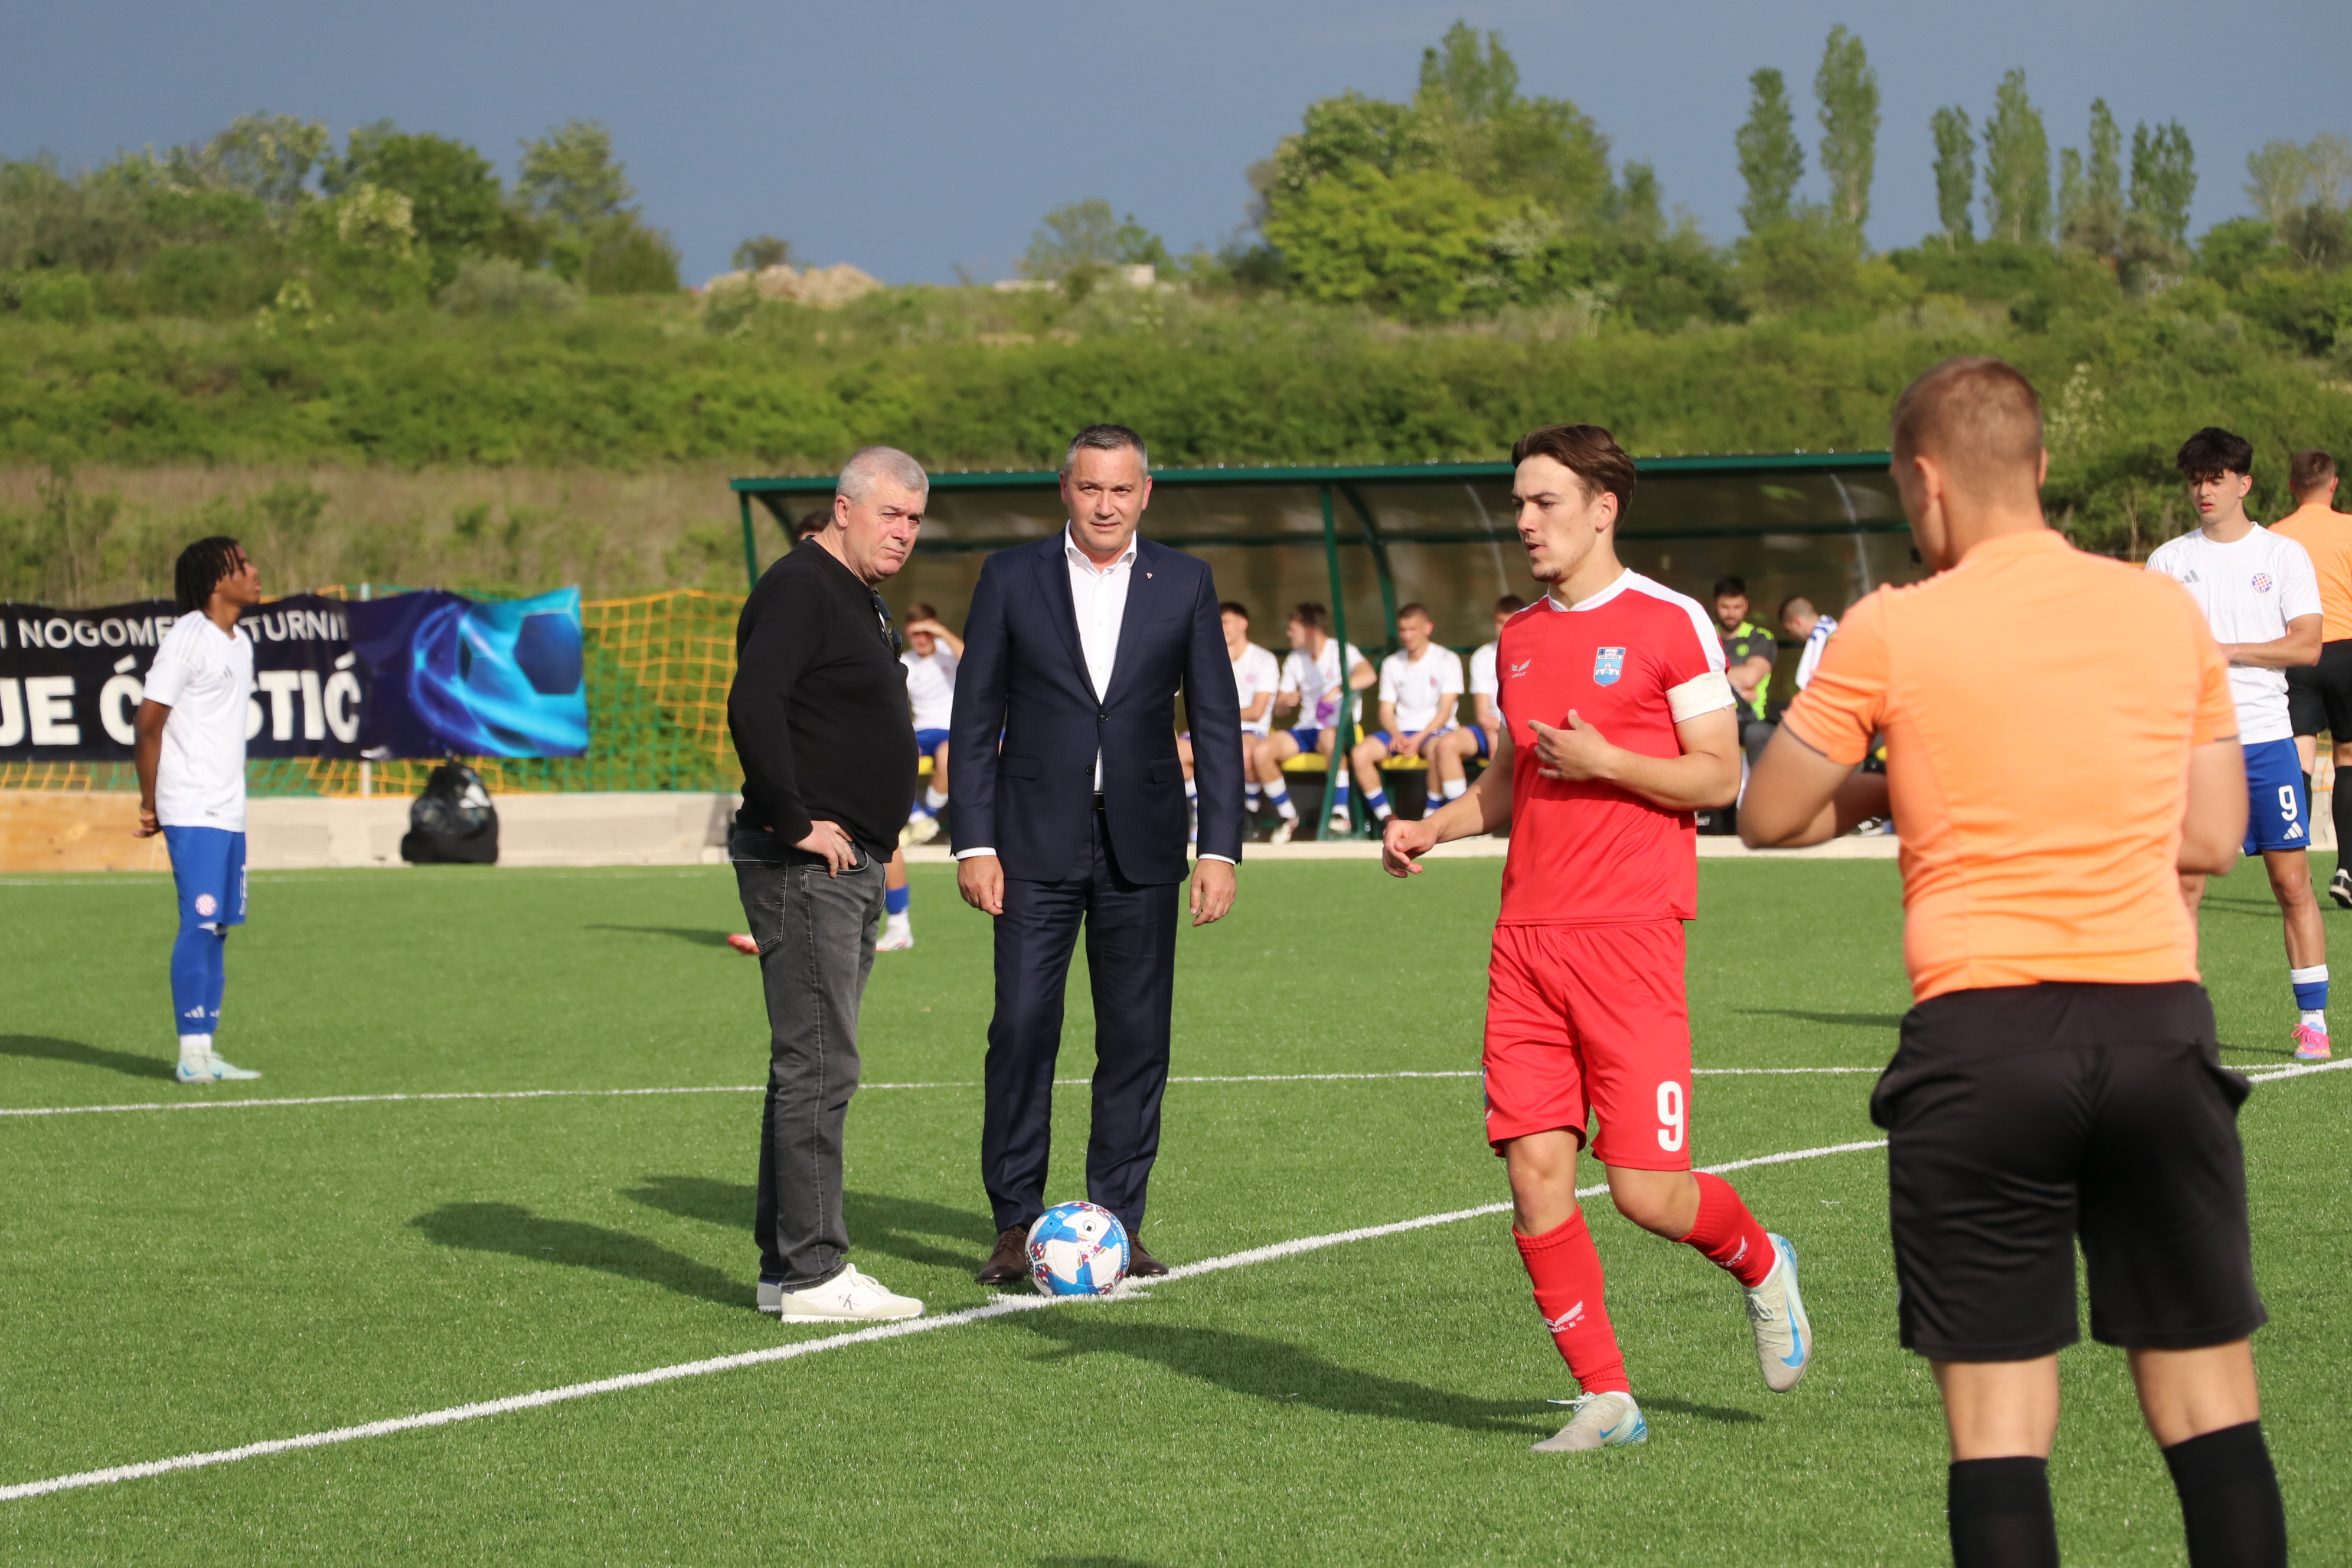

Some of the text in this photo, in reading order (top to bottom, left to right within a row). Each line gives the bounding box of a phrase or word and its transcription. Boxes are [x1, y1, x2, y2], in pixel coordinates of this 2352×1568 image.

[18, 616, 182, 648] NOGOME
[2278, 785, 2298, 821] 9
[1657, 1080, 1684, 1152] 9
